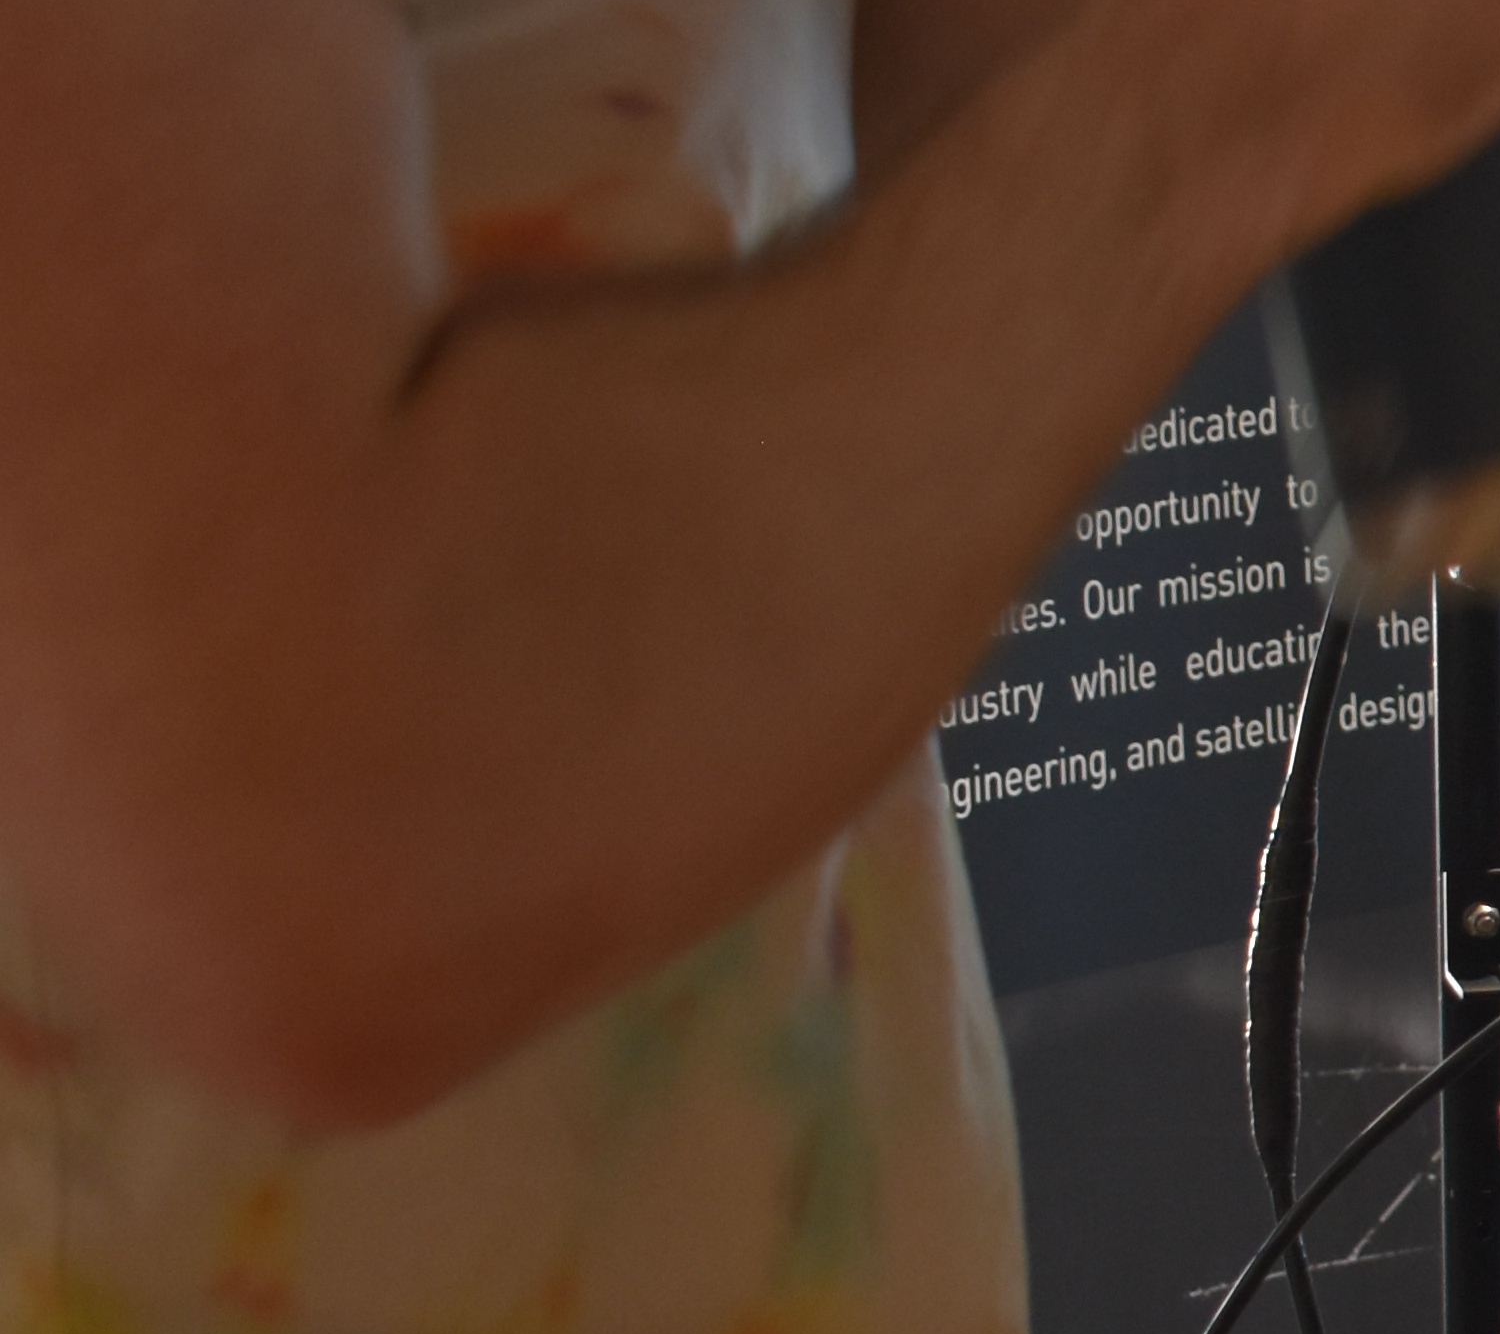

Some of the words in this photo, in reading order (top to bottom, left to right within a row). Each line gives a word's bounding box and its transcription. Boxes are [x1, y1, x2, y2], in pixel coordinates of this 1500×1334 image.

[1075, 479, 1261, 551] opportunity
[1286, 474, 1317, 510] to
[1083, 578, 1142, 620] Our
[1158, 555, 1285, 608] mission
[1303, 545, 1331, 584] is
[1071, 653, 1157, 703] while
[1378, 611, 1432, 650] the
[944, 746, 1117, 820] gineering,
[1127, 722, 1185, 772] and
